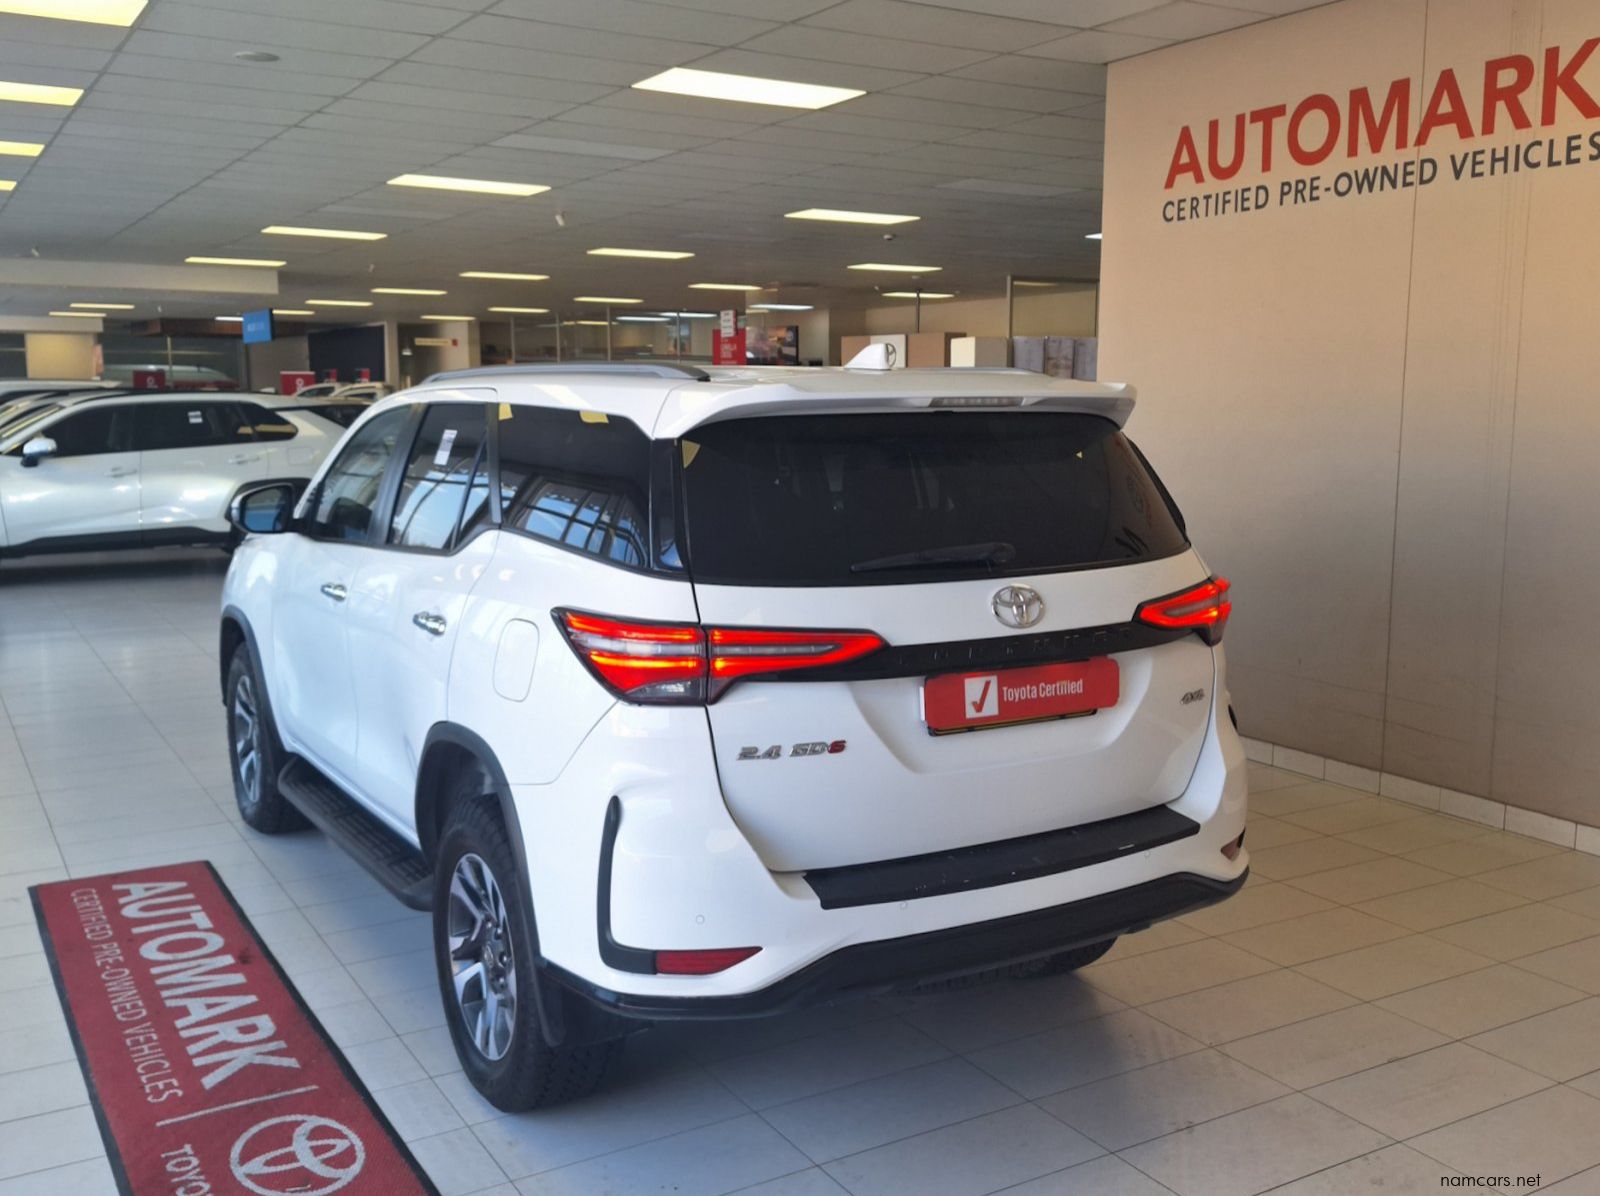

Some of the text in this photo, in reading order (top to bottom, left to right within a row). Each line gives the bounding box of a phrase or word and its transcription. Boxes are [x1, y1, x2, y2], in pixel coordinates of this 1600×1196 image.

[1164, 37, 1600, 190] AUTOMARK
[1162, 131, 1600, 223] CERTIFIED PRE-OWNED VEHICLES
[1002, 678, 1084, 702] Toyota Certified
[737, 745, 782, 760] 2.4
[70, 888, 184, 1104] CERTIFIED PRE-OWNED VEHICLES
[112, 881, 301, 1091] AUTOMARK
[160, 1143, 213, 1196] TOYO
